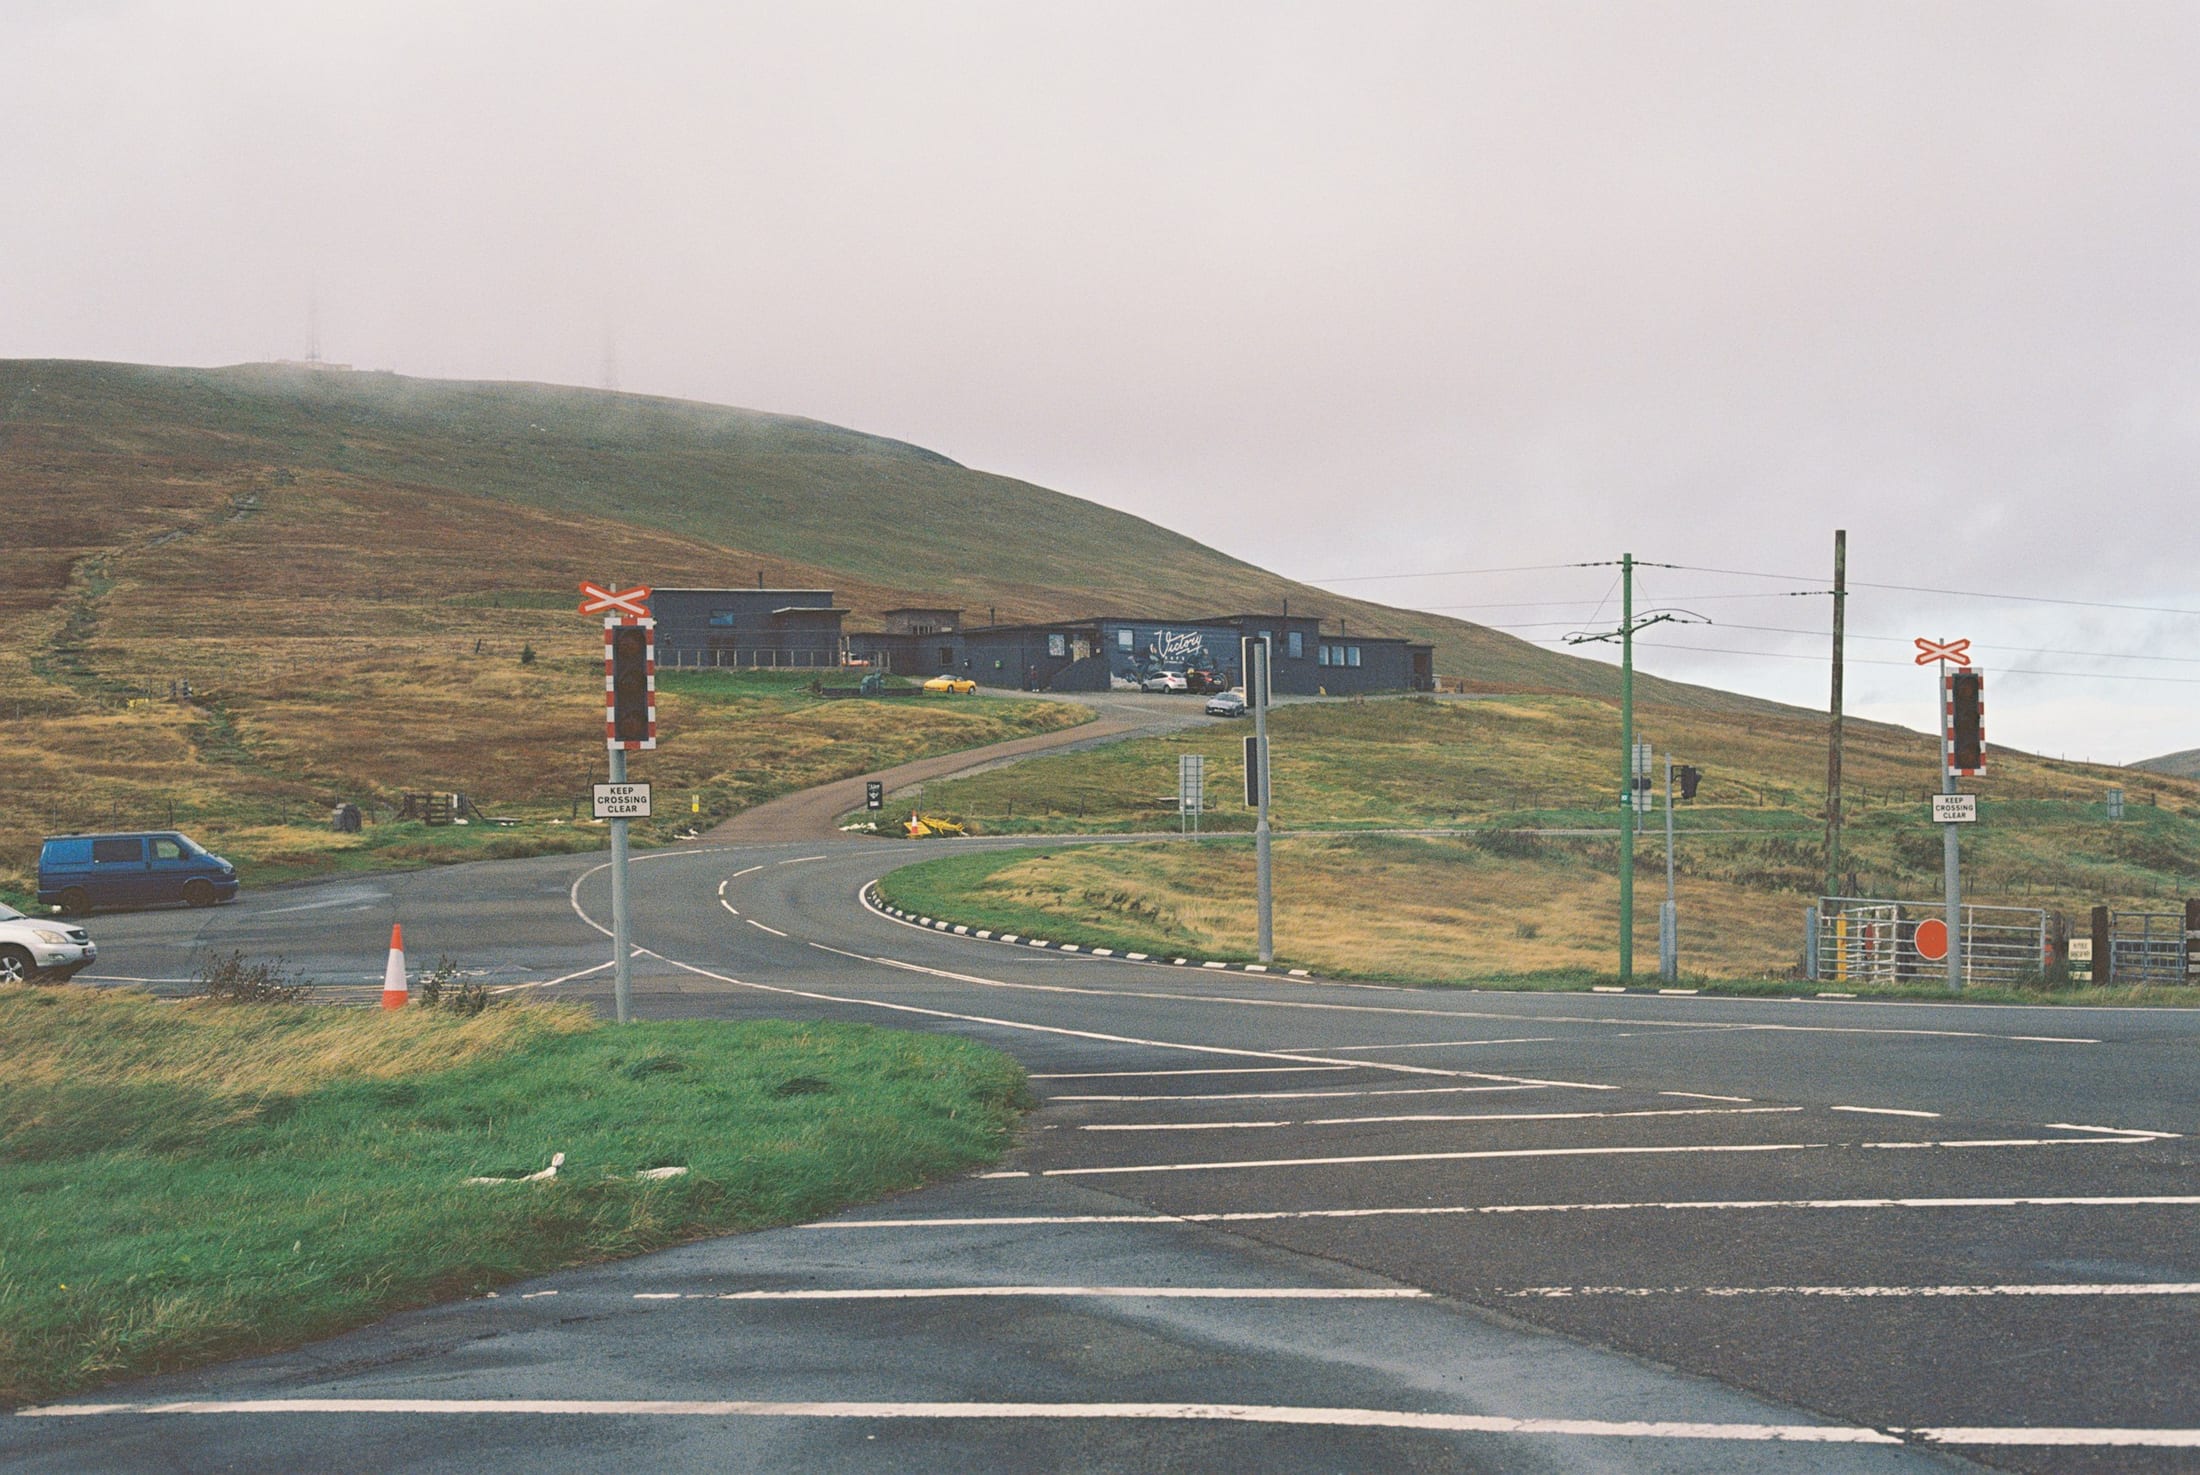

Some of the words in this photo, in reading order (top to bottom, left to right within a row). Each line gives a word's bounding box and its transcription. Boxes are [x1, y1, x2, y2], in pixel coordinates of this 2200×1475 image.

[1153, 630, 1202, 657] Victory
[610, 787, 634, 795] KEEP
[597, 796, 647, 804] CROSSING
[607, 805, 637, 813] CLEAR
